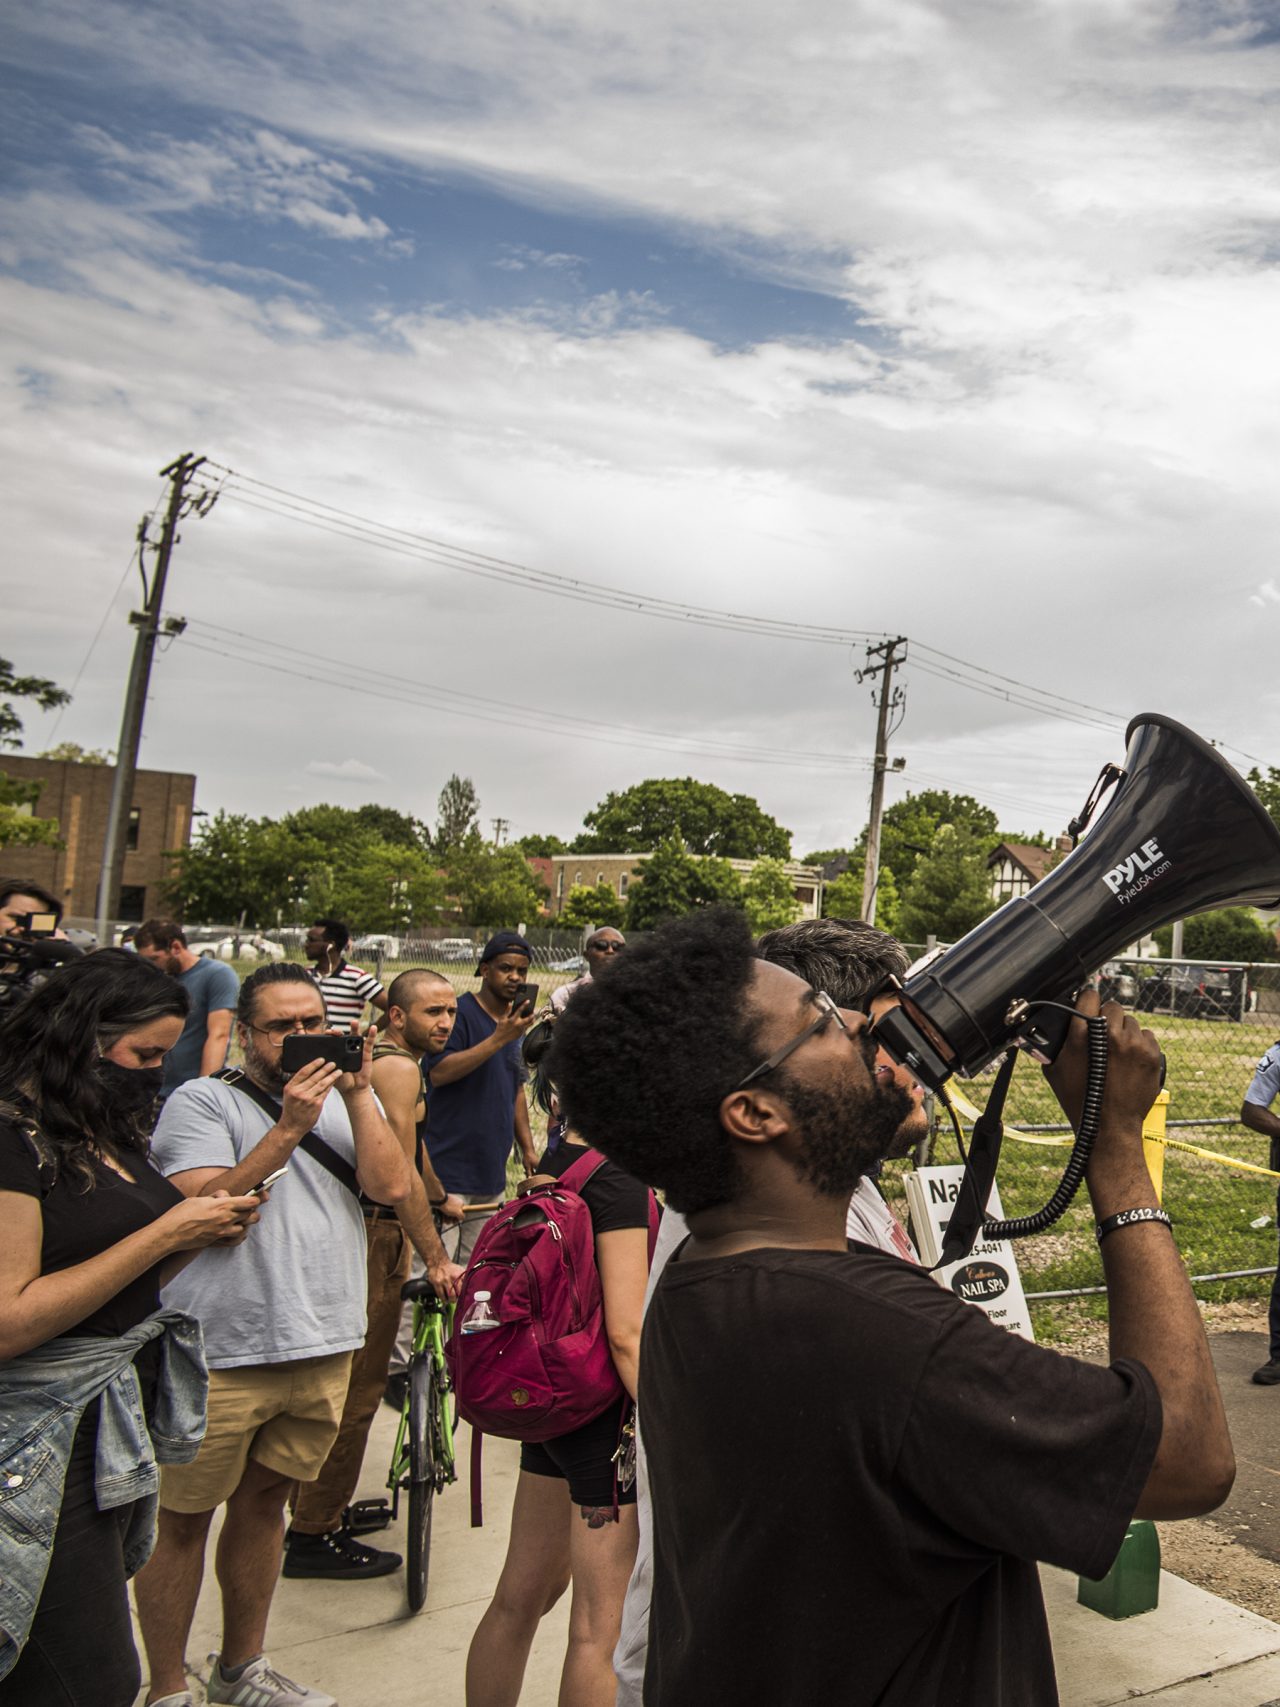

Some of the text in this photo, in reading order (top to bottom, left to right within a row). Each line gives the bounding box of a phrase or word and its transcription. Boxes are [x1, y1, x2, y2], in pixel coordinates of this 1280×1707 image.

[1102, 839, 1164, 894] PYLE
[1117, 860, 1172, 905] PyleUSA.com
[960, 1278, 1006, 1298] NAIL SPA
[988, 1309, 1007, 1319] Floor
